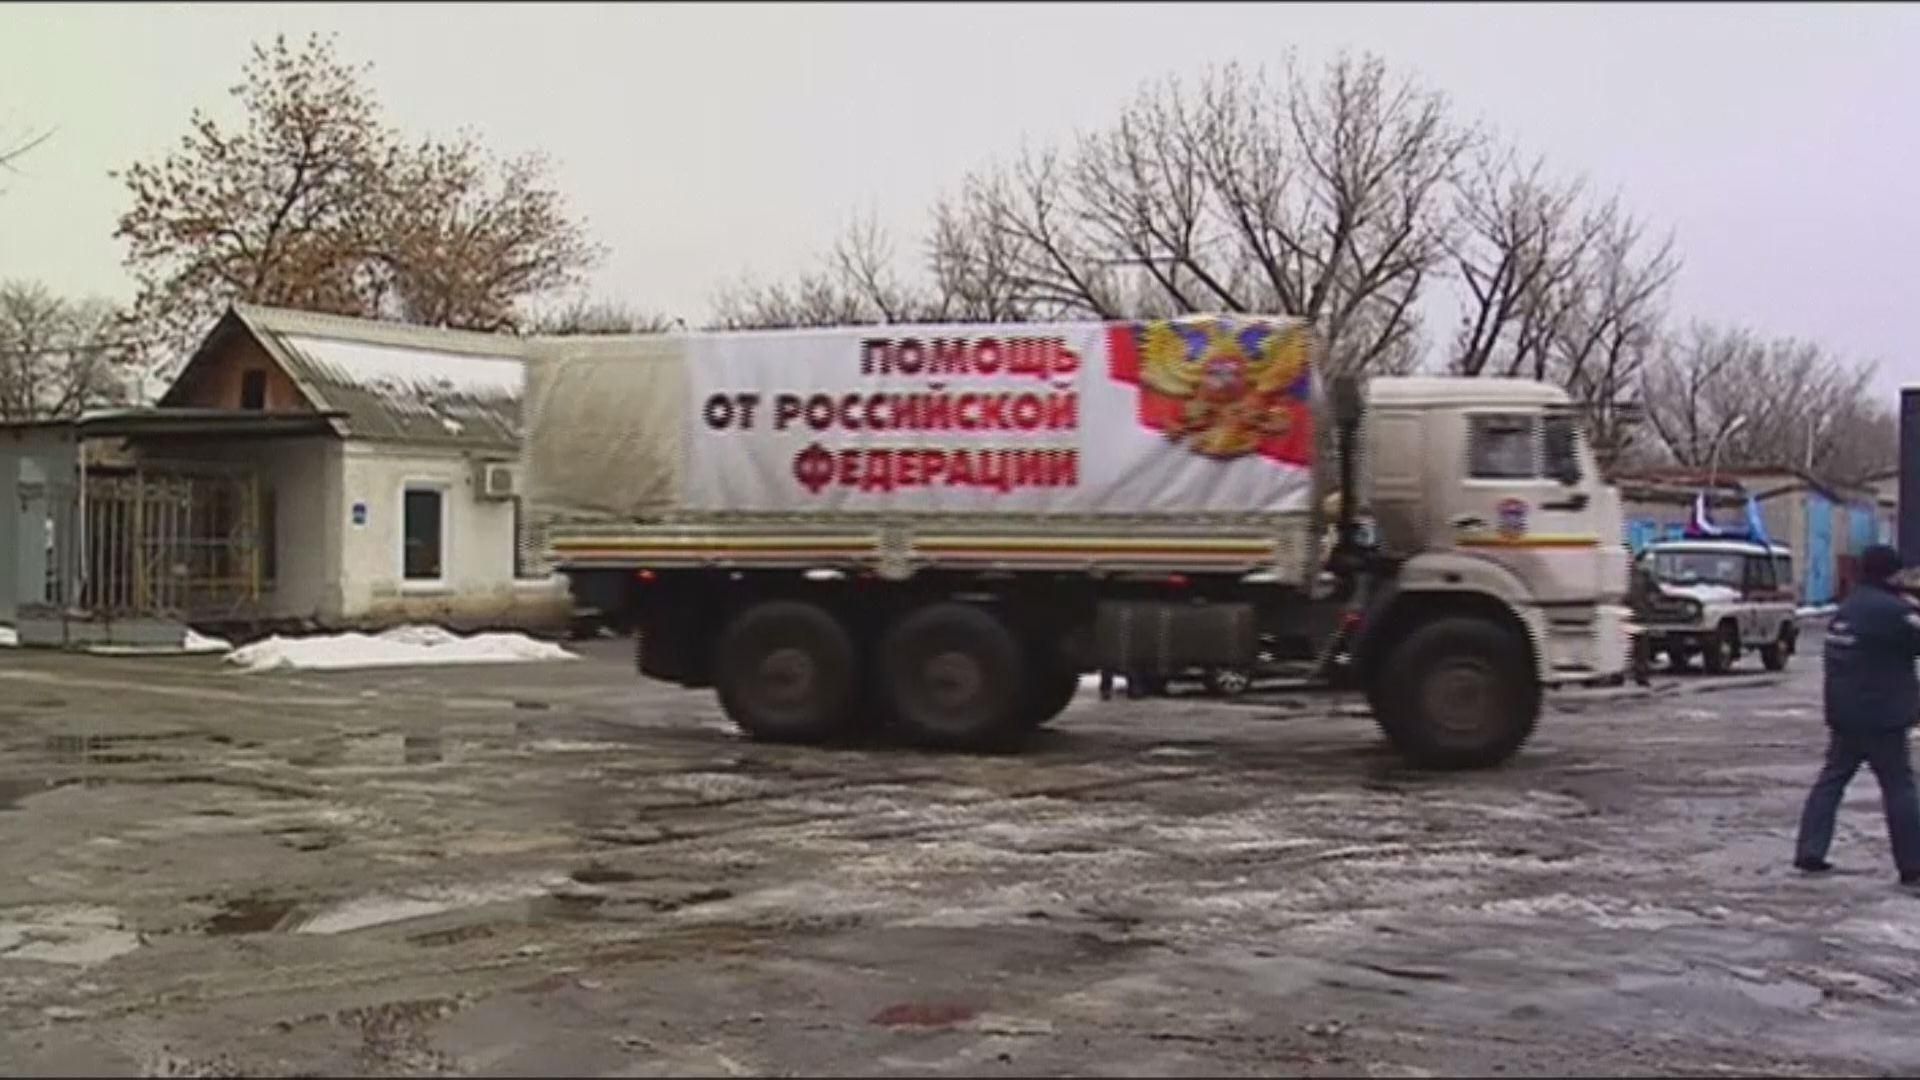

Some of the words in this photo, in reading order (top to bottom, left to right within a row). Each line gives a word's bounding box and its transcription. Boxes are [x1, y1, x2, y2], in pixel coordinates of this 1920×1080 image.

[860, 338, 1081, 379] ПОМОЩЬ
[704, 392, 761, 430] ОТ
[773, 382, 1080, 430] РОССИЙСКОЙ
[793, 443, 1080, 493] ФЕДЕРАЦИИ
